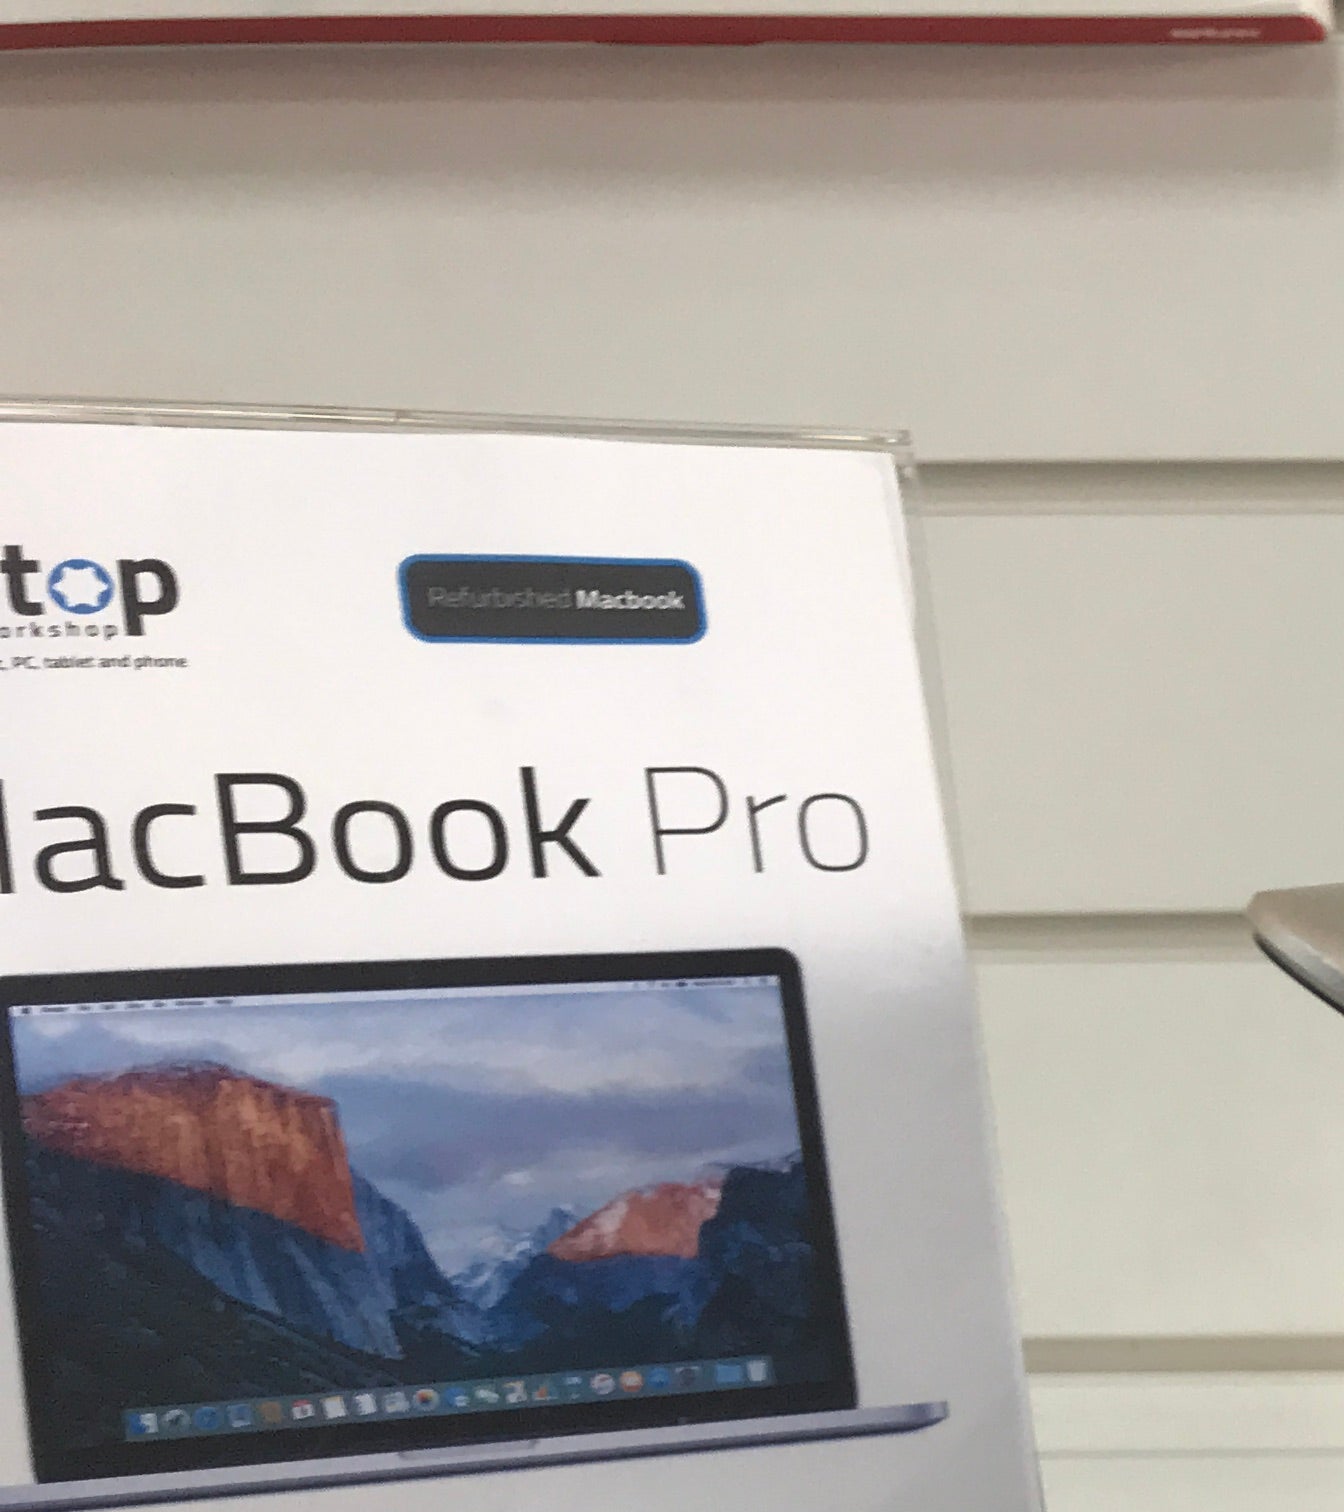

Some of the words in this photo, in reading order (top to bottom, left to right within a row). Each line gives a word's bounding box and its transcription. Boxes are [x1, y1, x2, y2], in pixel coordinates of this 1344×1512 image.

[574, 588, 686, 610] Macbook
[0, 765, 602, 895] acBook
[645, 765, 872, 877] Pro
